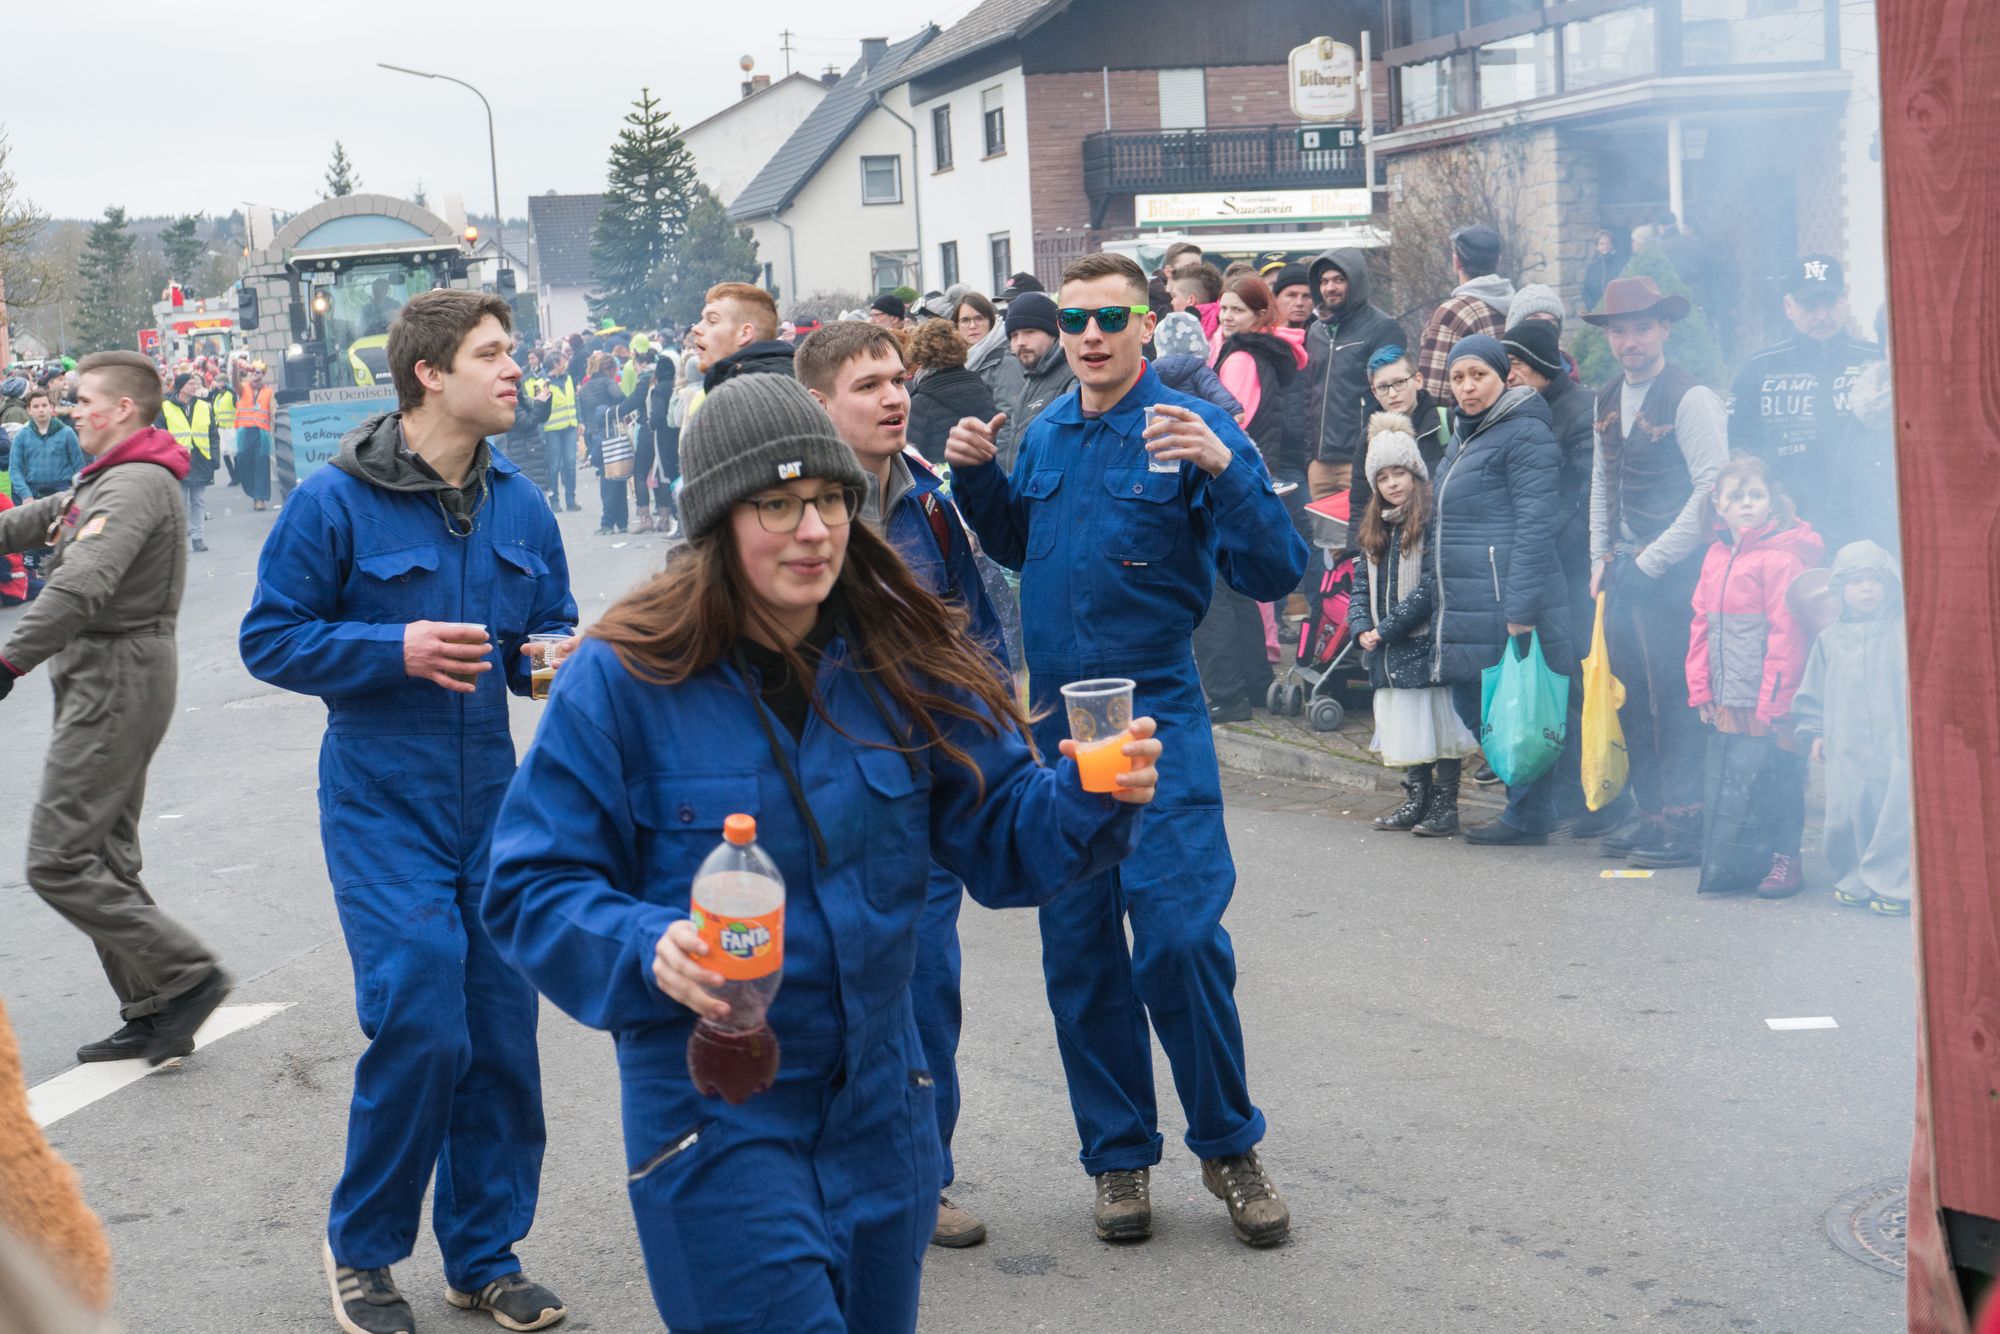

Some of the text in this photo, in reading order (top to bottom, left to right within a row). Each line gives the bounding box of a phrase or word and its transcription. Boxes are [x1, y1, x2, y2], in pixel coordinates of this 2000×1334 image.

[1299, 70, 1352, 87] Bitburger
[1804, 261, 1828, 280] NY
[314, 391, 333, 402] KV
[1761, 396, 1814, 416] BLUE
[778, 461, 802, 479] CAT
